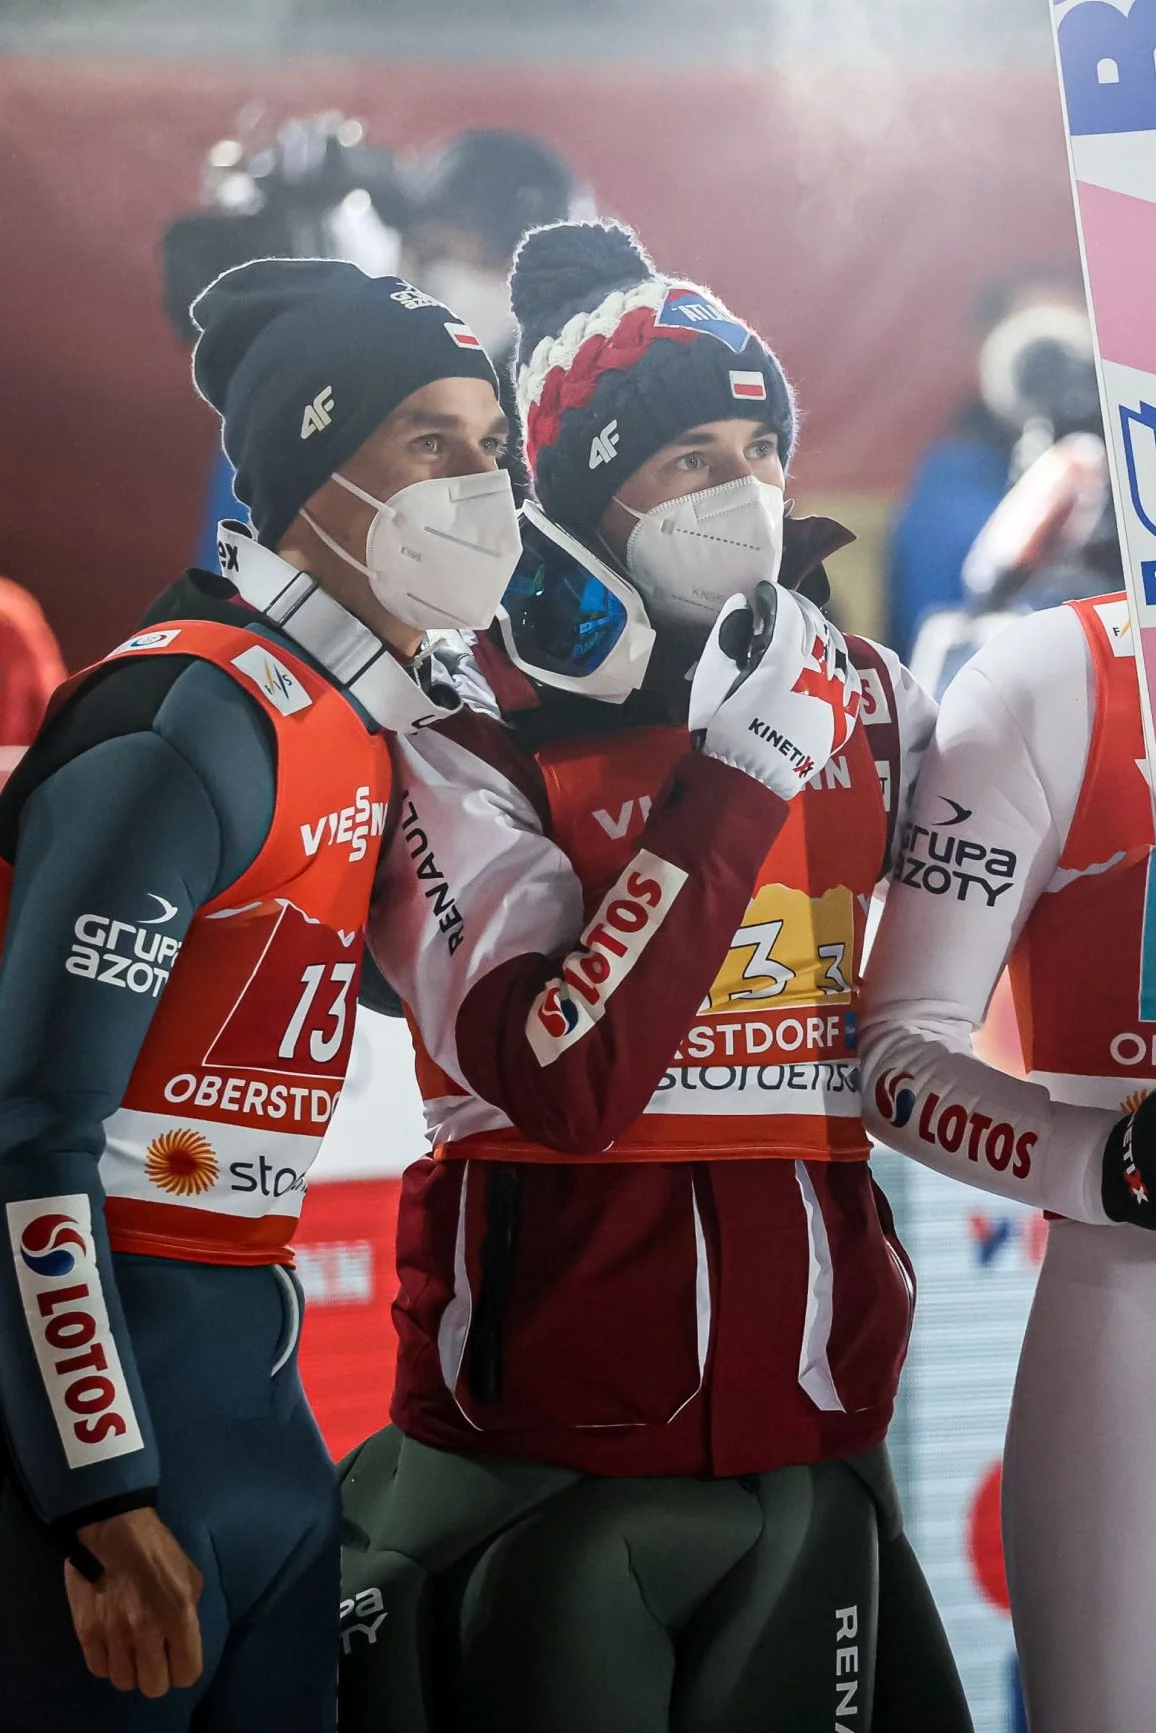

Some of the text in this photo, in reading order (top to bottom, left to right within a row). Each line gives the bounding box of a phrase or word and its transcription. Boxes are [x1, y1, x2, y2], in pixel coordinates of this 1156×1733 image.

[300, 386, 335, 440] 4F
[588, 419, 620, 470] 4F
[402, 789, 466, 957] RENAUL
[564, 870, 663, 1006] LOTOS
[278, 962, 357, 1063] 13
[918, 1092, 1039, 1180] LOTOS
[36, 1283, 126, 1445] LOTOS
